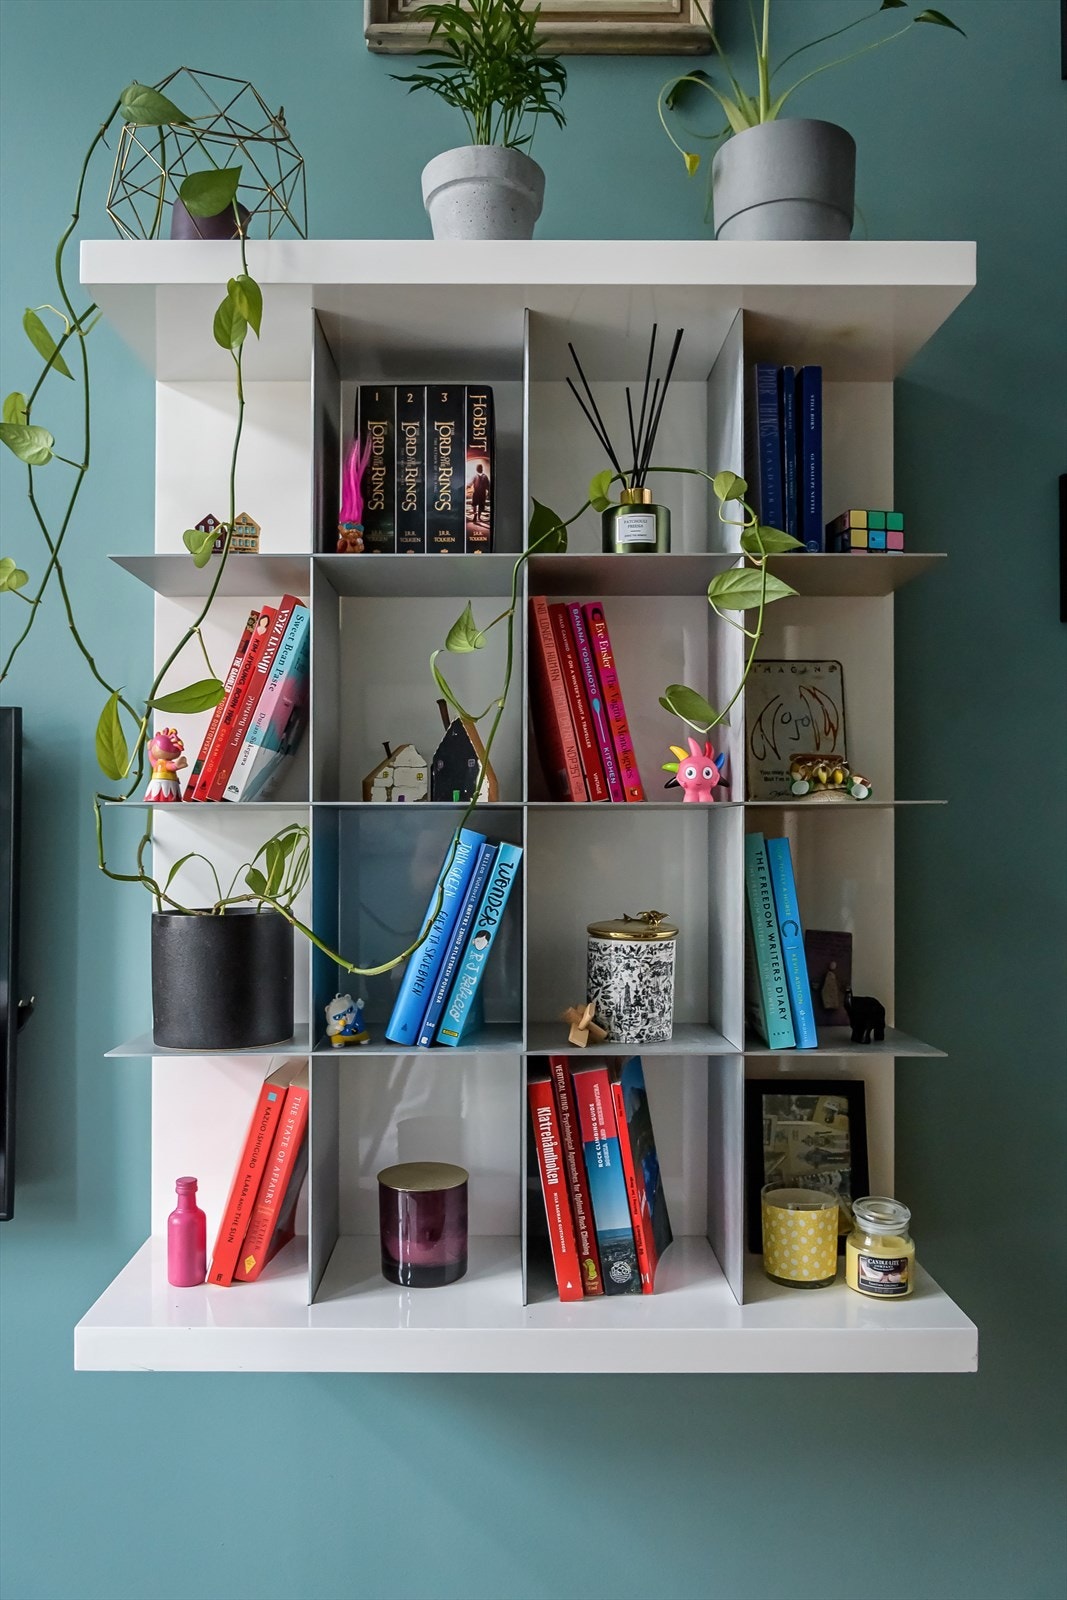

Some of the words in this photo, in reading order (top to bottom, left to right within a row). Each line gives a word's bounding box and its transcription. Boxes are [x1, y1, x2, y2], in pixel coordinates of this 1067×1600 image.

[759, 369, 777, 395] POOR
[375, 392, 379, 401] 1
[407, 393, 413, 403] 2
[441, 393, 448, 403] 3
[469, 395, 487, 452] HOBBIT
[760, 403, 778, 437] THINGS
[368, 420, 388, 455] LORD
[402, 422, 419, 456] LORD
[434, 421, 454, 455] LORD
[368, 467, 386, 510] RINGS
[402, 467, 418, 511] RINGS
[435, 467, 453, 511] RINGS
[537, 603, 547, 615] NO
[256, 635, 279, 674] UHVATI
[273, 607, 290, 635] ZECA
[287, 614, 304, 642] Sweet
[540, 618, 554, 648] LONGER
[561, 629, 570, 652] CALVINO
[595, 622, 607, 639] Eve
[250, 638, 260, 652] KIM
[277, 643, 294, 669] Bean
[572, 608, 586, 644] BANANA
[581, 646, 597, 695] YOSHIMOTO
[598, 640, 613, 669] Ensler
[232, 656, 243, 668] THE
[236, 653, 255, 688] JIYOUNG,
[547, 651, 560, 681] HUMAN
[224, 667, 239, 694] GAMBLER
[268, 668, 284, 693] Paste
[606, 674, 617, 689] The
[229, 687, 243, 709] BORN
[568, 660, 574, 669] ON
[571, 674, 581, 698] WINTER'S
[581, 721, 592, 748] TRAVELLER
[607, 693, 624, 723] Vagina
[223, 709, 234, 726] 1982
[252, 712, 266, 736] Durian
[201, 718, 219, 755] DOSTOEVSKY
[217, 728, 227, 743] CHO
[231, 727, 243, 747] Lana
[239, 735, 258, 767] Sukegawa
[565, 745, 581, 779] NDP357
[615, 724, 636, 779] Monologues
[603, 747, 617, 784] KITCHEN
[592, 772, 602, 794] VINTAGE
[454, 841, 473, 866] JOHN
[479, 852, 490, 874] Milica
[755, 851, 765, 872] THE
[444, 866, 465, 899] GREEN
[759, 876, 774, 928] FREEDOM
[428, 934, 441, 946] TA
[411, 946, 437, 997] SKJEBNEN
[767, 933, 782, 982] WRITERS
[791, 953, 799, 974] KEVIN
[775, 987, 788, 1021] DIARY
[794, 976, 804, 1004] ASHTON
[555, 1064, 566, 1092] VERTICAL
[260, 1106, 272, 1132] KAZUO
[289, 1096, 302, 1116] THE
[280, 1118, 295, 1147] STATE
[537, 1106, 563, 1185] Klatrehåndboken
[561, 1113, 575, 1151] Psychological
[592, 1122, 601, 1150] CLIMBING
[248, 1132, 264, 1169] ISHIGURO
[276, 1150, 286, 1164] OF
[567, 1151, 580, 1183] Approaches
[240, 1174, 252, 1197] KLARA
[264, 1166, 281, 1205] AFFAIRS
[574, 1193, 585, 1215] Optimal
[232, 1212, 241, 1226] THE
[578, 1216, 587, 1230] Rock
[227, 1227, 237, 1243] SUN
[254, 1218, 269, 1251] ESTHER
[579, 1230, 591, 1256] Climbing
